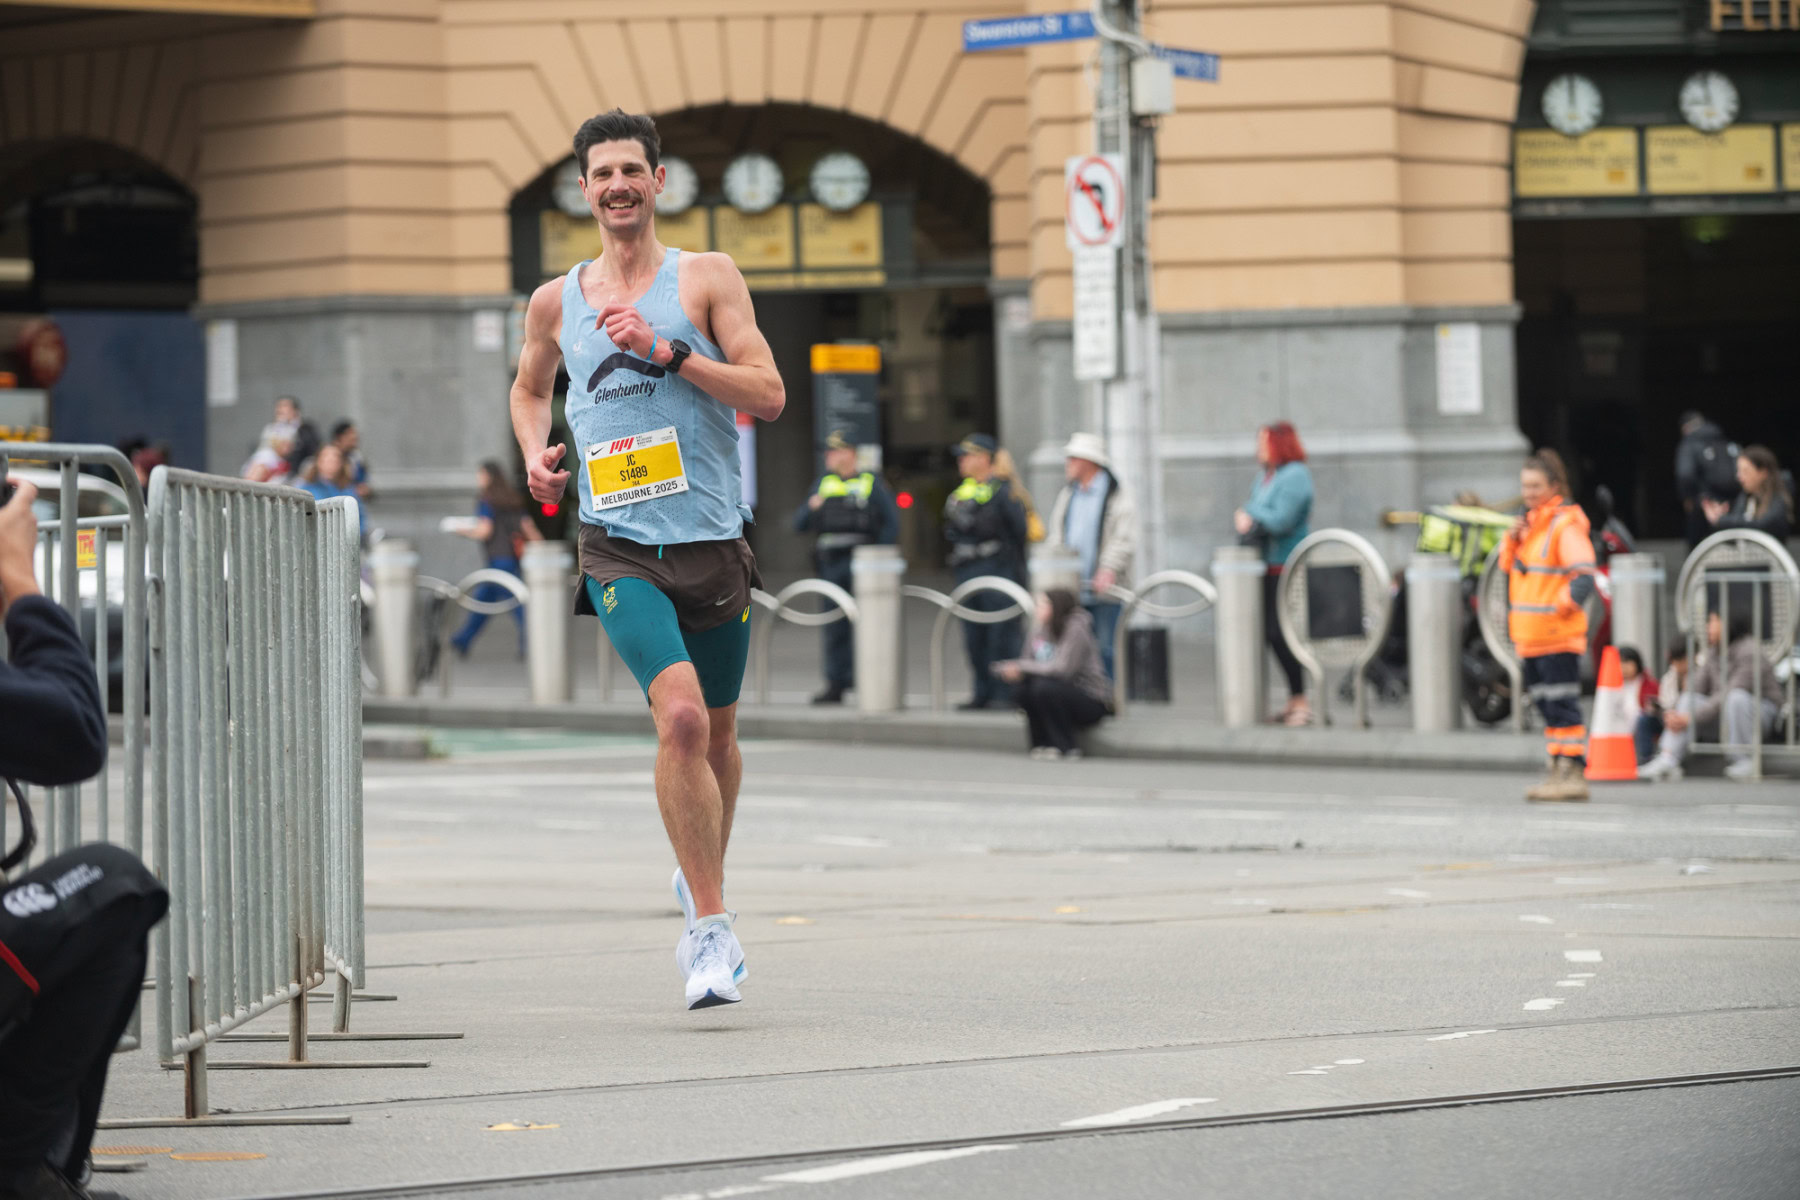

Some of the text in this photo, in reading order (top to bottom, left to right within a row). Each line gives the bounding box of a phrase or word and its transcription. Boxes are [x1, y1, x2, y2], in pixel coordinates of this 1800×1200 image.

[595, 380, 657, 404] Glenhuntly
[626, 454, 636, 466] JC
[620, 465, 648, 482] S1489
[601, 481, 678, 506] MELBOURNE 2025
